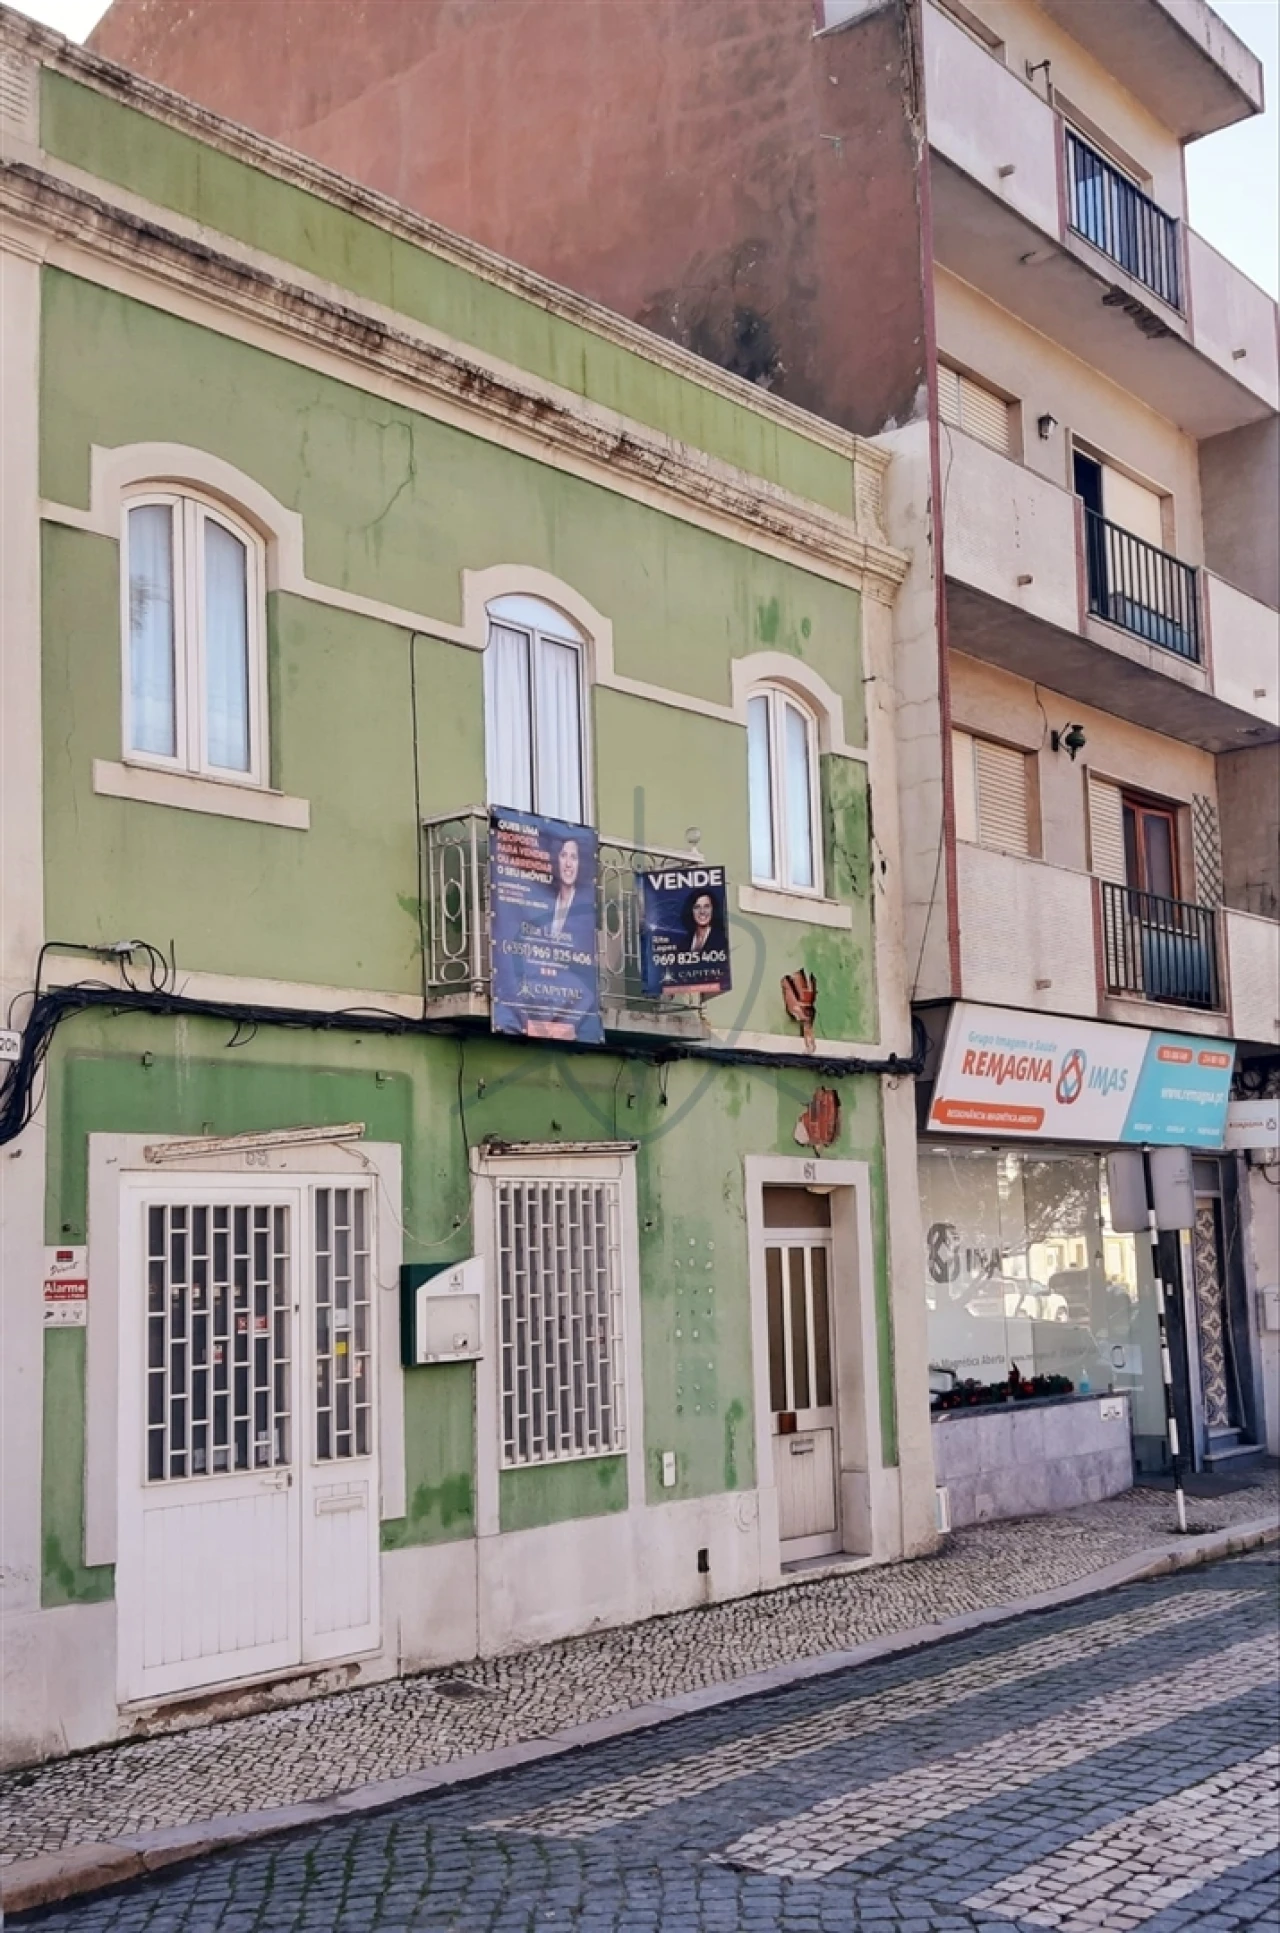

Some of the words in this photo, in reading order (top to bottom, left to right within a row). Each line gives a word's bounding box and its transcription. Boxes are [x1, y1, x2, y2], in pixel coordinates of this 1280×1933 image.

[648, 869, 722, 890] VENDE
[652, 953, 676, 966] 969
[677, 951, 700, 965] 825
[701, 950, 726, 963] 406
[678, 968, 724, 978] CAPITAL
[961, 1048, 1053, 1085] REMAGNA
[1088, 1065, 1128, 1096] IMAS
[44, 1281, 85, 1293] Alarme
